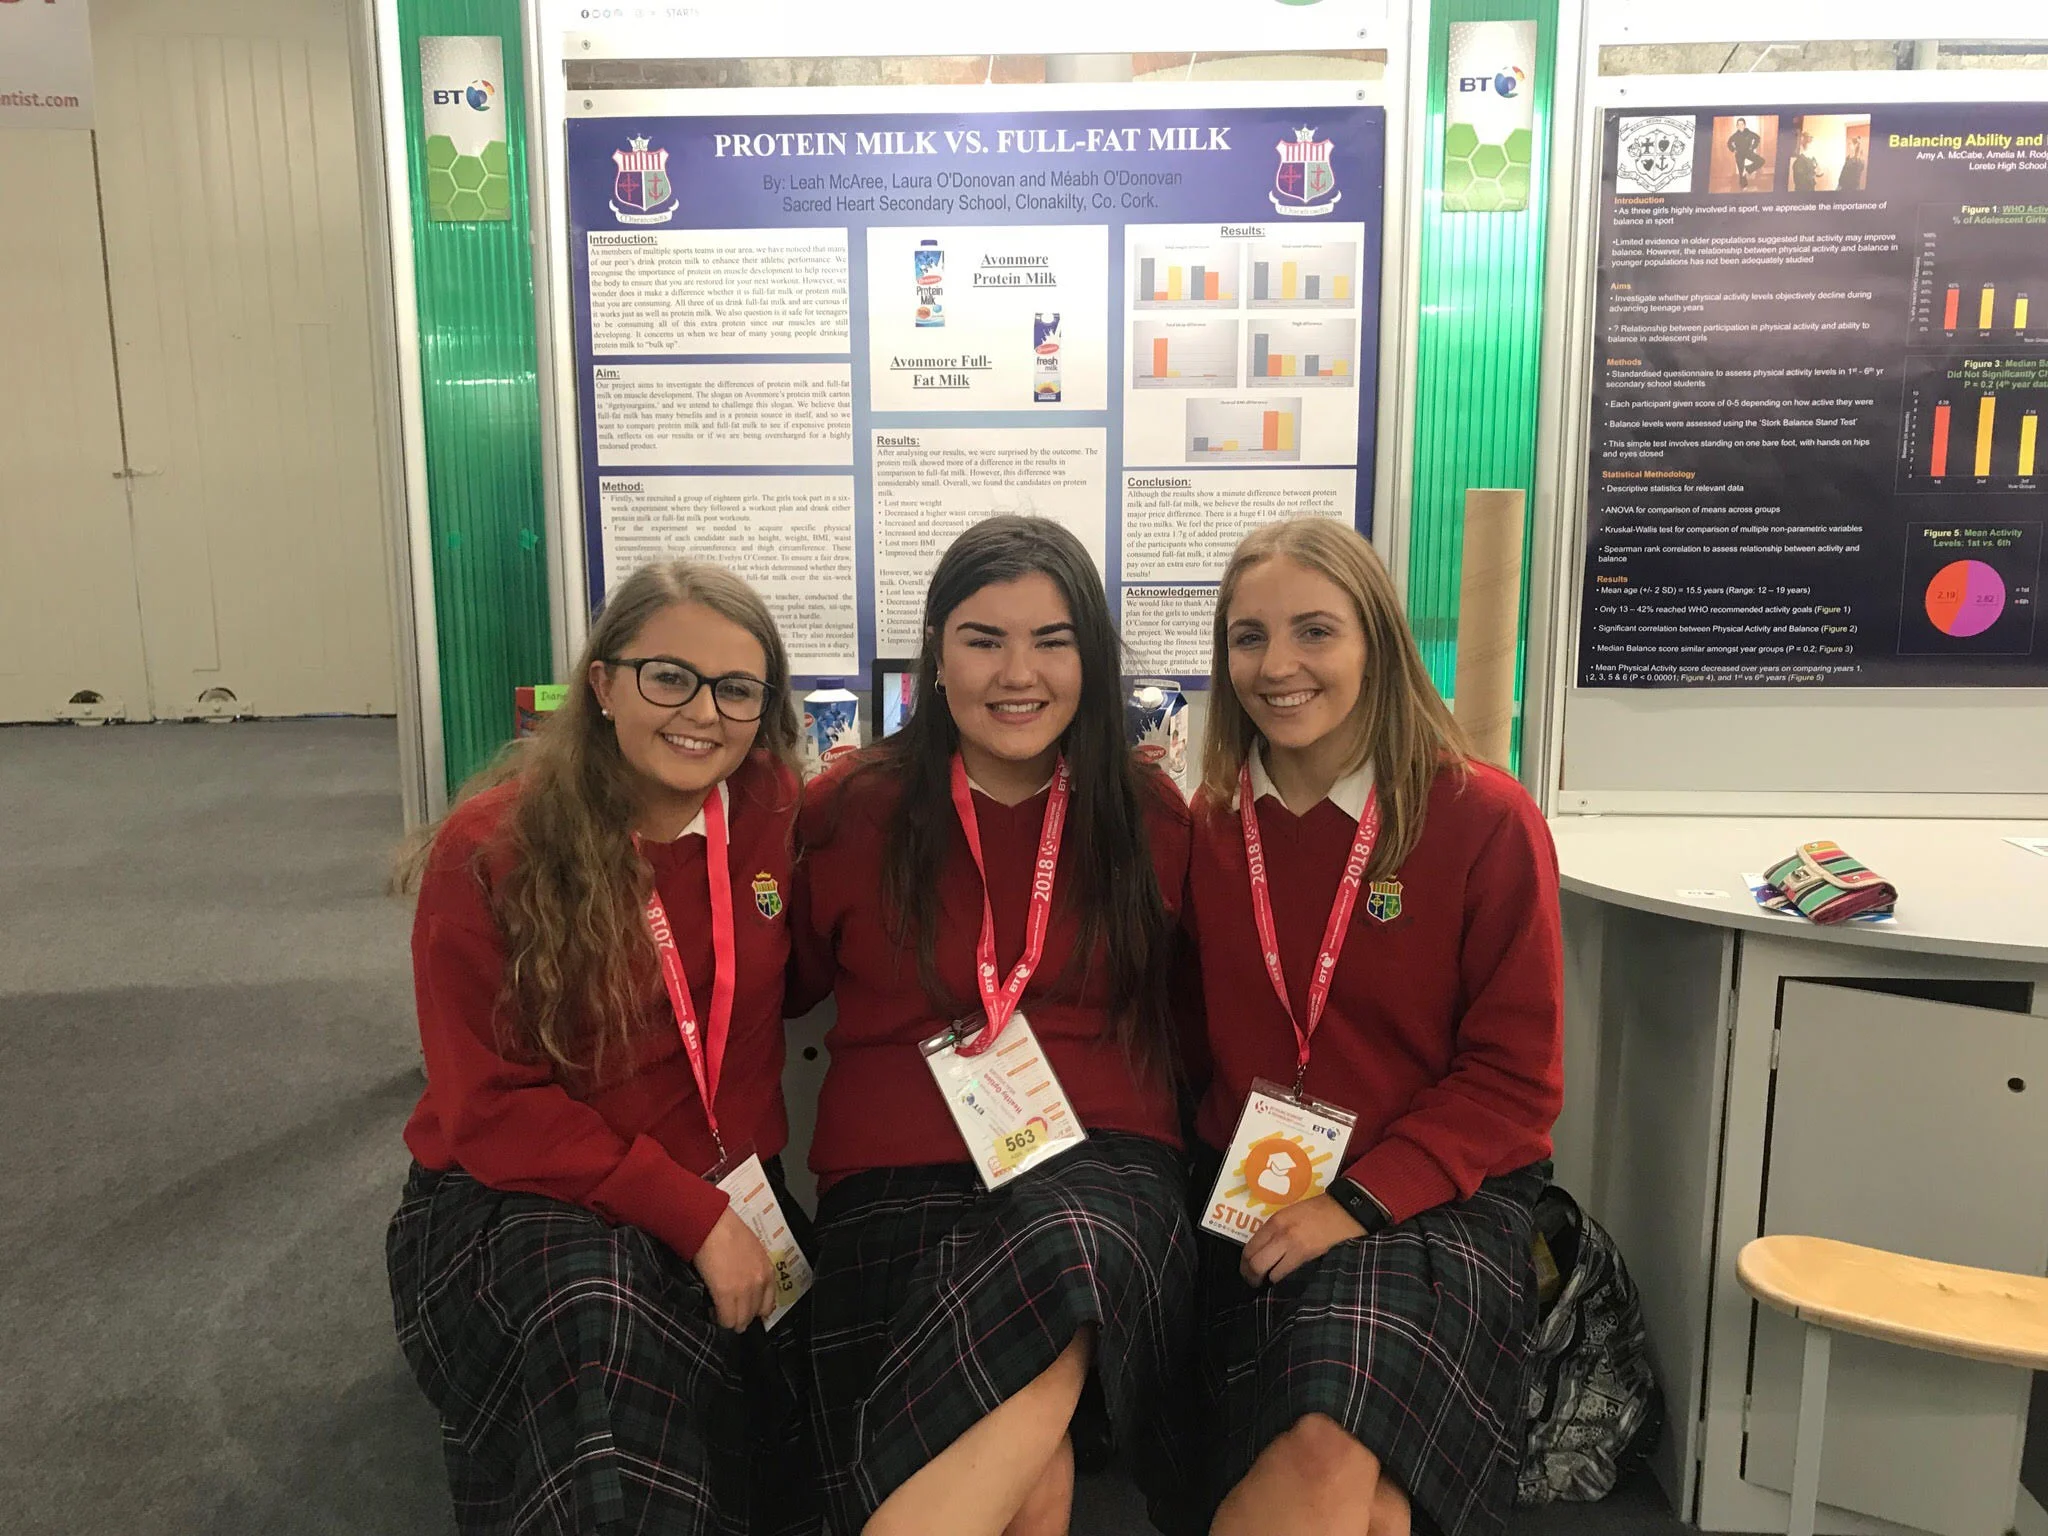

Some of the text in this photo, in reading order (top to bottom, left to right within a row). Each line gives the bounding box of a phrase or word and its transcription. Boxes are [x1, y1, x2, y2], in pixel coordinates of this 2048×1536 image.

[1460, 77, 1492, 92] BT
[0, 90, 80, 108] ntist.com
[433, 90, 464, 104] BT
[714, 126, 1230, 157] PROTEIN MILK VS. FULL-FAT MILK
[1889, 133, 2042, 149] Balancing Ability and
[1916, 151, 1935, 160] Amy
[1948, 150, 1984, 159] McCabe,
[1985, 150, 2014, 158] Amelia
[1997, 162, 2016, 171] High
[2018, 161, 2046, 169] School
[763, 169, 1182, 194] By: Leah McAree, Laura O'Donovan and Méabh O'Donovan
[782, 192, 1158, 214] Sacred Heart Secondary School, Clonakilty, Co. Cork.
[1961, 205, 1990, 215] Figure
[2003, 205, 2024, 214] WHO
[1654, 217, 1674, 225] sport
[1973, 216, 2023, 224] Adolescent
[1221, 226, 1265, 237] Results:
[589, 234, 657, 246] Introduction:
[981, 255, 1048, 267] Avonmore
[974, 272, 1055, 286] Protein Milk
[916, 286, 943, 296] Protein
[1614, 294, 1656, 303] Investigate
[1690, 293, 1721, 302] physical
[1722, 293, 1750, 301] activity
[1775, 292, 1816, 301] objectively
[1846, 290, 1872, 299] during
[920, 295, 935, 305] Milk
[1609, 304, 1648, 313] advancing
[890, 354, 992, 369] Avonmore Full-
[1036, 357, 1058, 366] fresh
[1964, 360, 1992, 369] Figure
[595, 368, 619, 380] Aim:
[1982, 370, 2036, 379] Significantly
[914, 374, 969, 388] Fat Milk
[877, 435, 920, 446] Results:
[1643, 470, 1695, 479] Methodology
[601, 482, 643, 493] Method:
[1127, 477, 1191, 488] Conclusion:
[1127, 490, 1158, 498] Although
[1923, 529, 1951, 538] Figure
[1058, 776, 1067, 792] BT
[1248, 843, 1265, 885] 2018
[1344, 843, 1370, 888] 2018
[1034, 859, 1054, 902] 2018
[646, 906, 674, 949] 2018
[1319, 968, 1328, 984] BT
[985, 977, 994, 993] BT
[1009, 977, 1021, 993] BT
[688, 1034, 698, 1050] BT
[1313, 1124, 1326, 1134] BT
[1005, 1129, 1035, 1152] 563
[776, 1261, 792, 1291] 543
